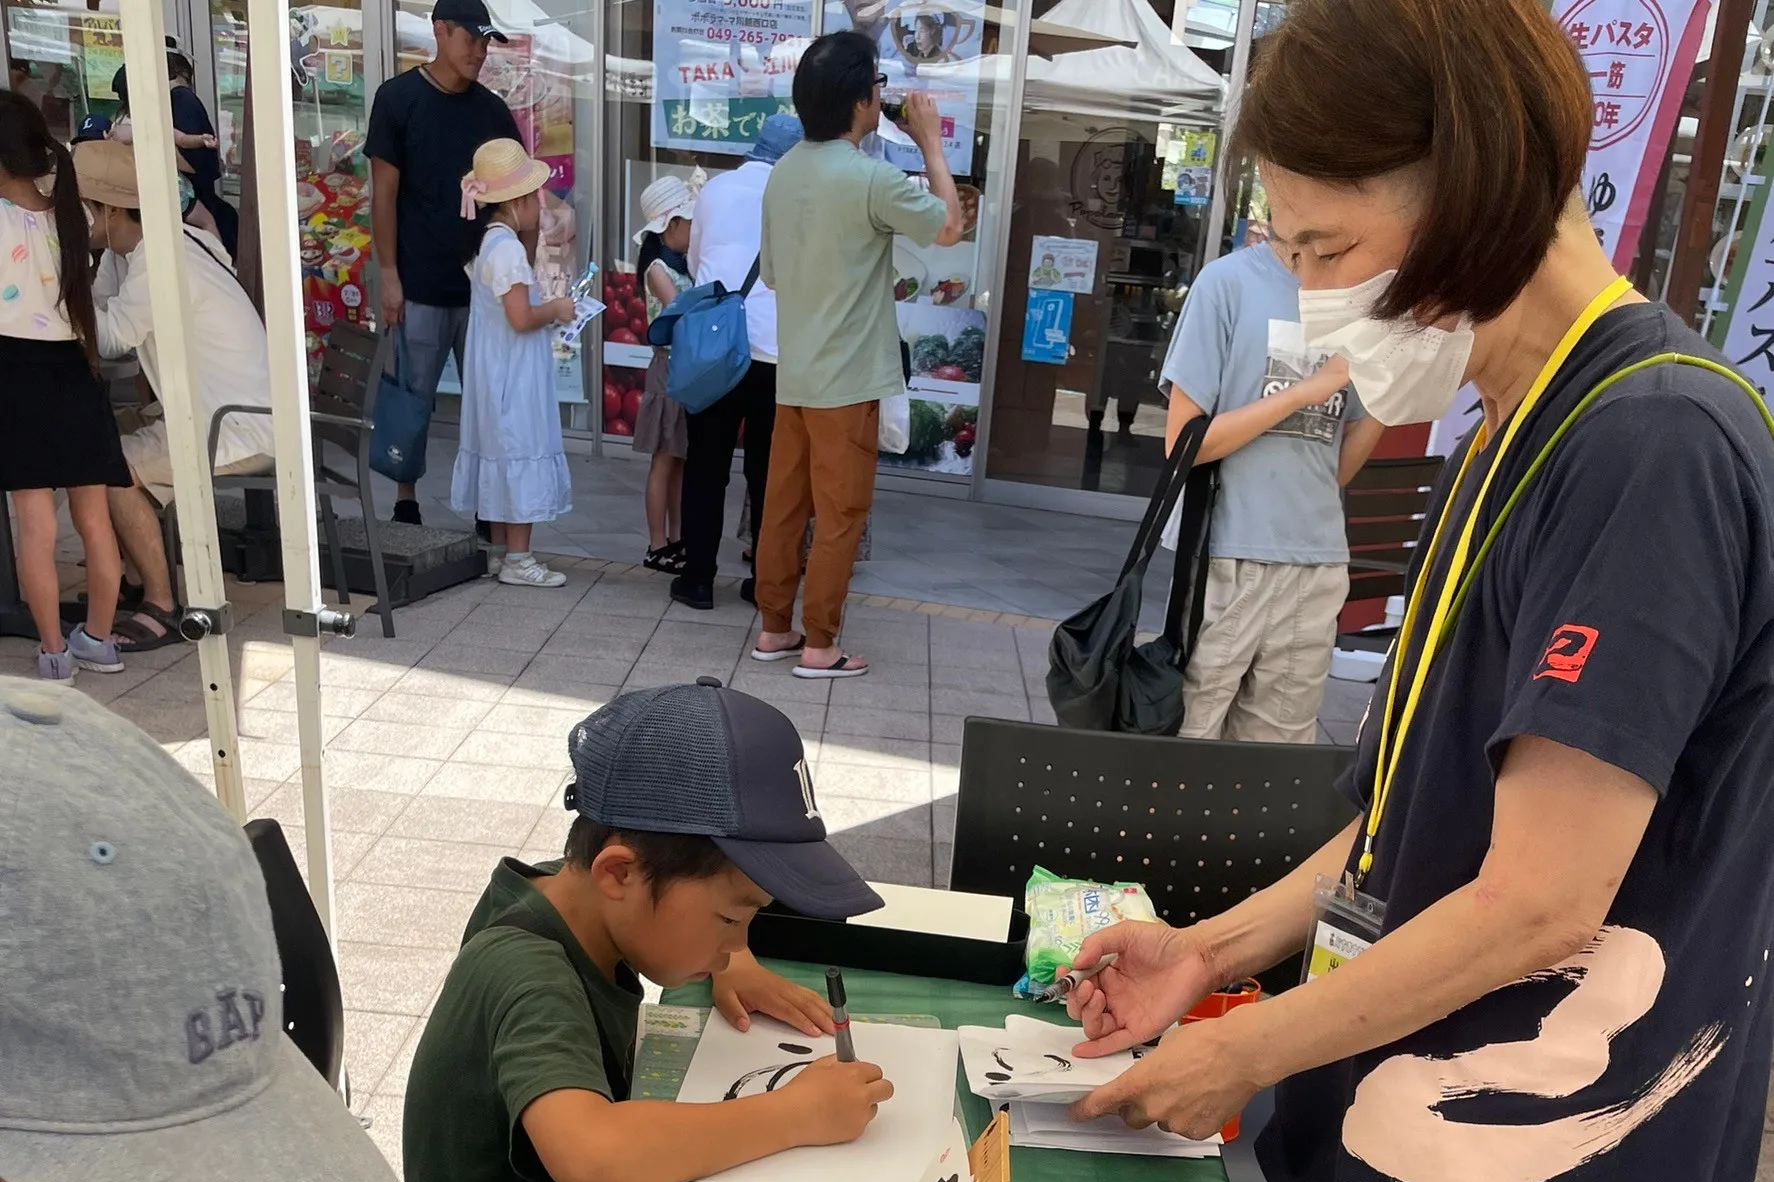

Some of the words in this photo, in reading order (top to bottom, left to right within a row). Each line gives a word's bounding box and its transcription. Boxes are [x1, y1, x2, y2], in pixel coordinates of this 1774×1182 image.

[1570, 20, 1655, 49] 生パスタ
[678, 61, 735, 84] TAKA
